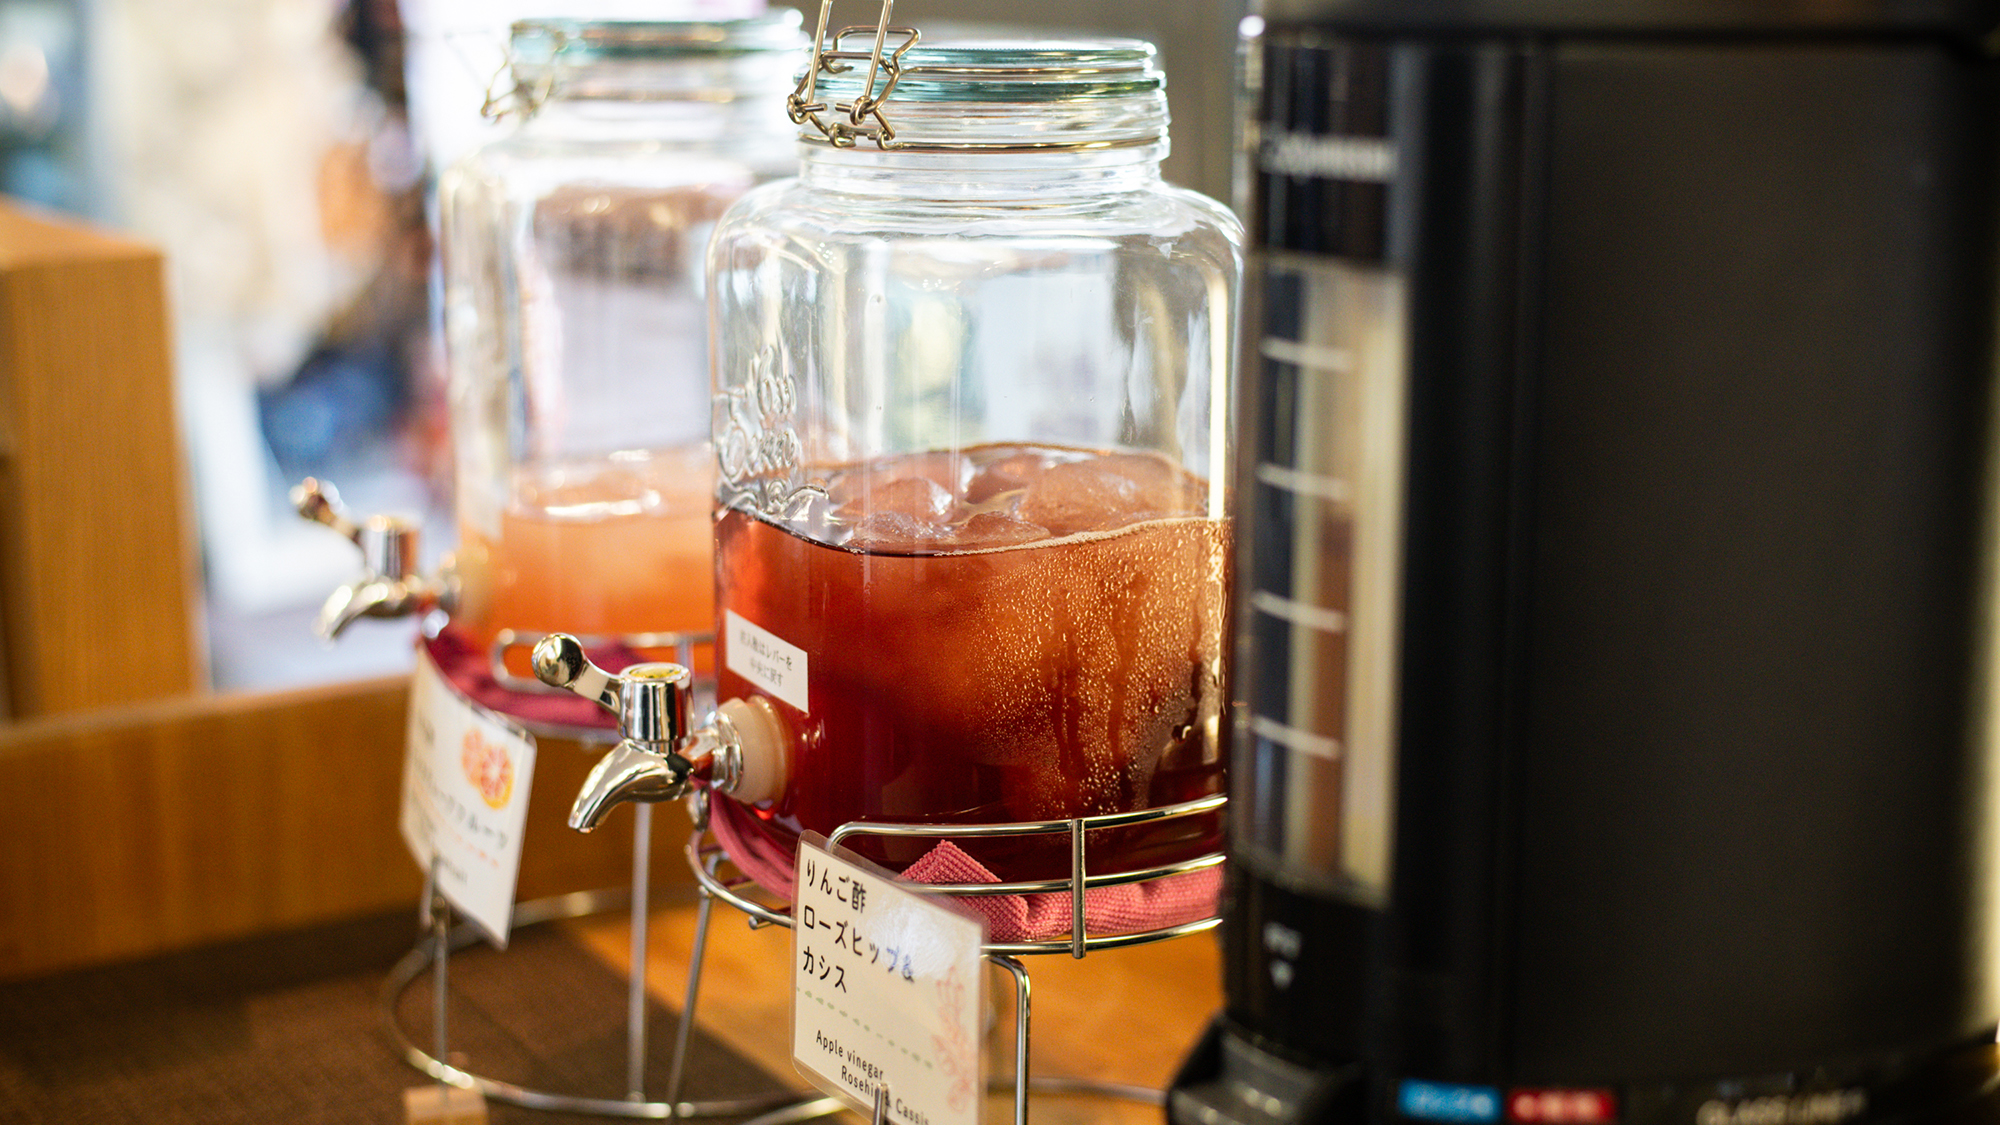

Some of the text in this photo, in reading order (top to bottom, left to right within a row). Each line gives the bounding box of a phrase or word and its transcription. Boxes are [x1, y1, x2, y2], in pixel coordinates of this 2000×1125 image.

[806, 859, 867, 914] りんご酢
[803, 946, 847, 994] カシス
[816, 1029, 884, 1080] Apple vinegar
[841, 1065, 877, 1099] Rosehi
